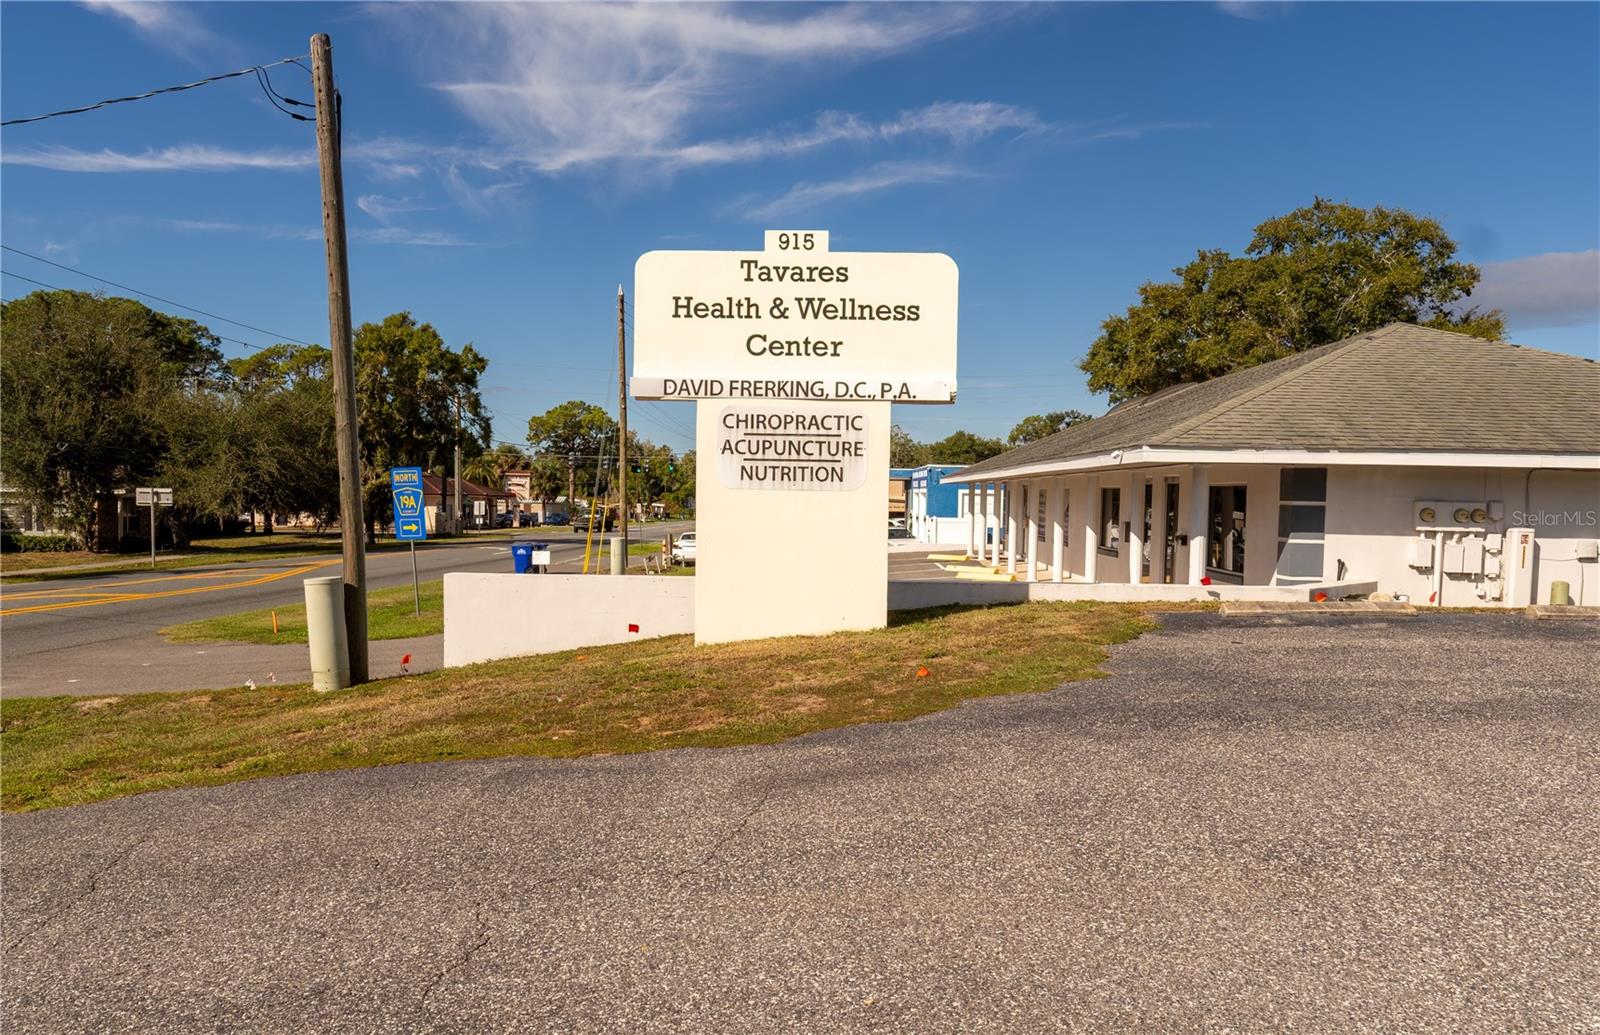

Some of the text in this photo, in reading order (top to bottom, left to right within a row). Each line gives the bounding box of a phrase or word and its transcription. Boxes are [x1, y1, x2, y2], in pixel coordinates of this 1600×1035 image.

[778, 232, 815, 251] 915
[740, 259, 849, 283] Tavares
[671, 296, 920, 322] Health & Wellness
[746, 334, 844, 357] Center
[663, 379, 917, 400] DAVID FRERKING, D.C., P.A.
[722, 413, 863, 431] CHIROPRACTIC
[721, 439, 864, 457] ACUPUNCTURE
[394, 473, 418, 483] NORTH
[740, 465, 844, 483] NUTRITION
[400, 495, 417, 508] 19A
